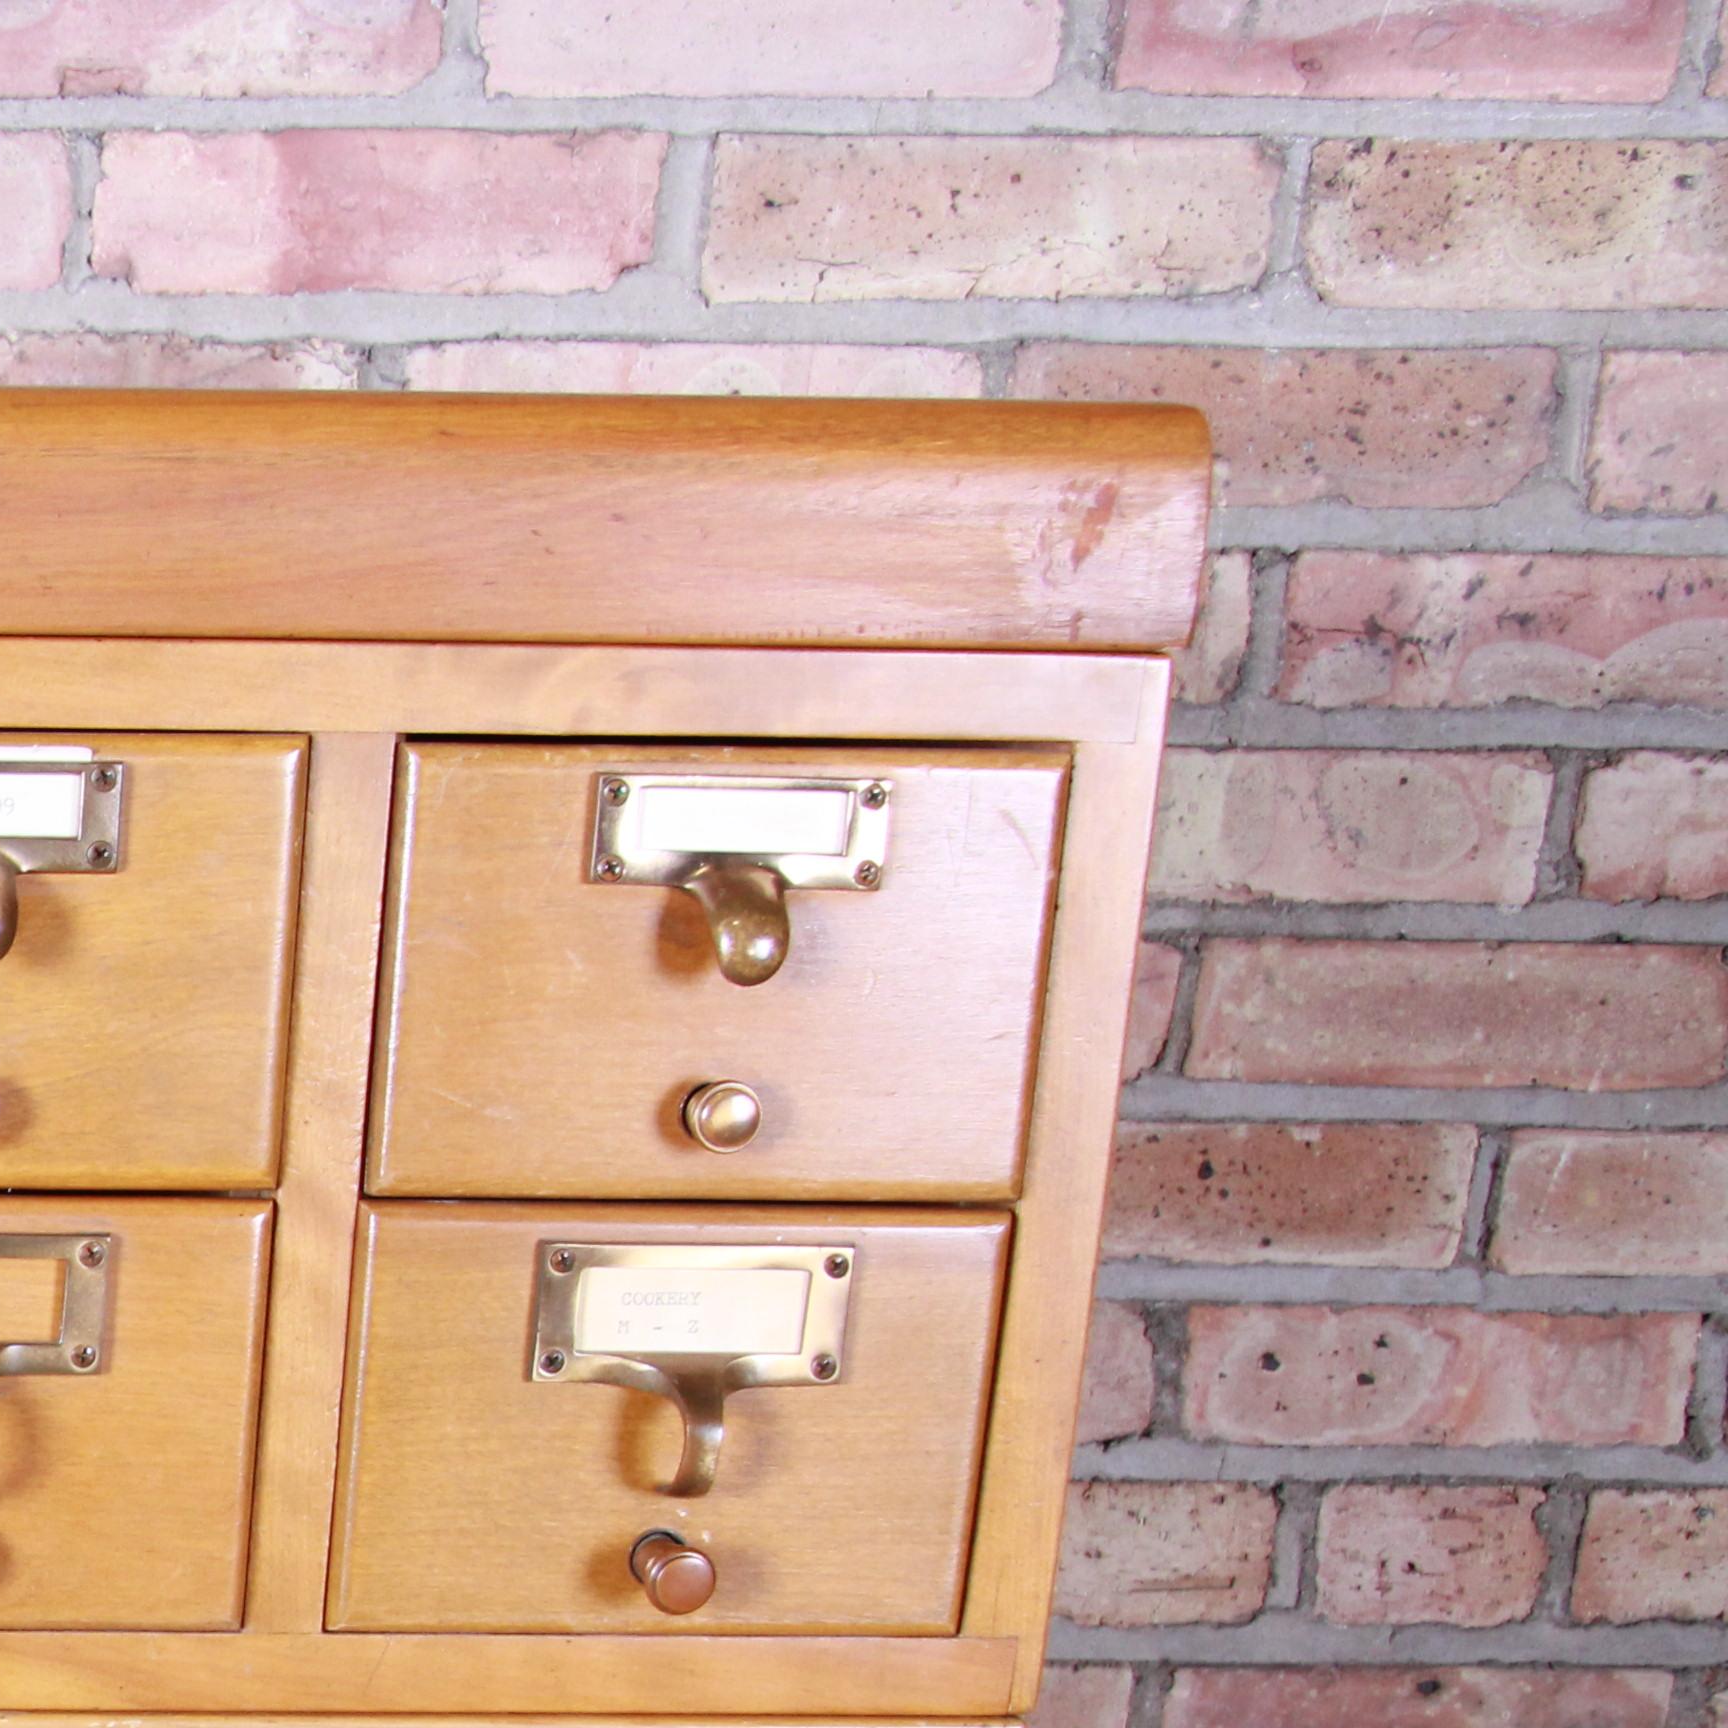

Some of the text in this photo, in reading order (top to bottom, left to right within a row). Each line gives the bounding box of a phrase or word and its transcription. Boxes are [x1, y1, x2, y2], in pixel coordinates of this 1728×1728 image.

[621, 1292, 703, 1306] COOKERY
[616, 1320, 630, 1334] M
[687, 1320, 699, 1334] Z
